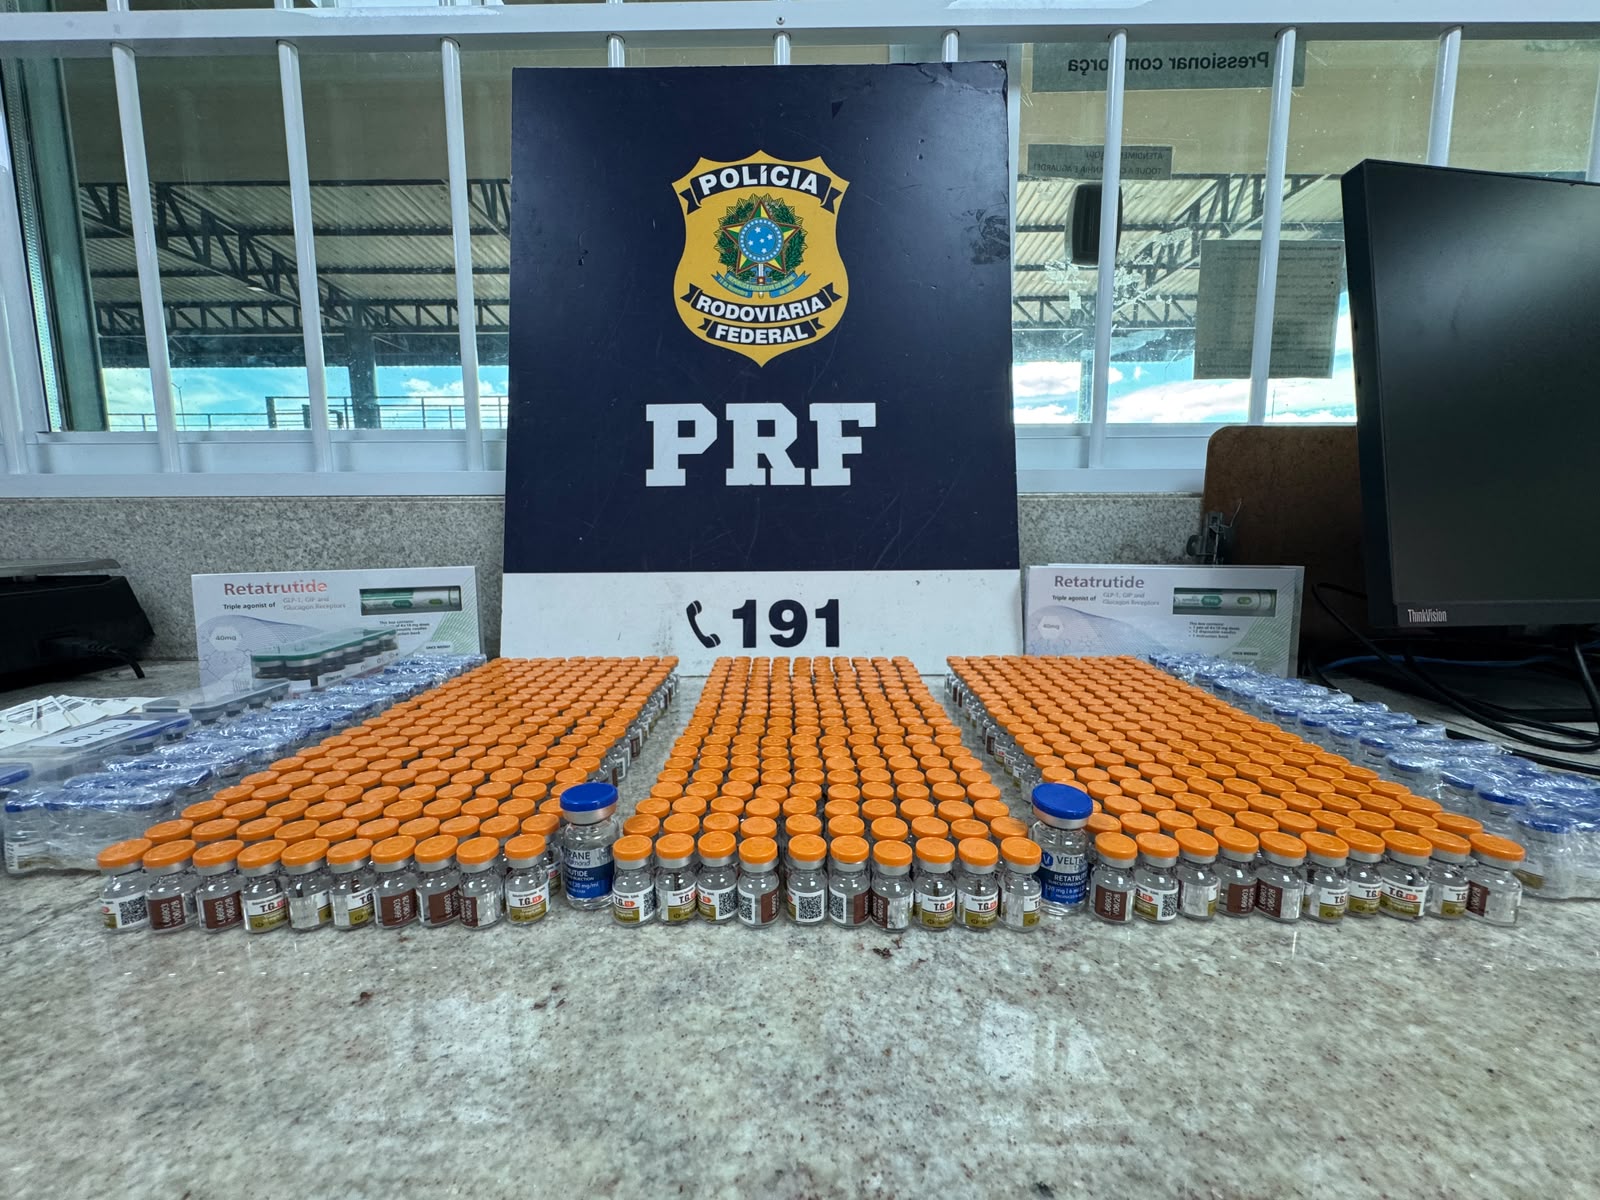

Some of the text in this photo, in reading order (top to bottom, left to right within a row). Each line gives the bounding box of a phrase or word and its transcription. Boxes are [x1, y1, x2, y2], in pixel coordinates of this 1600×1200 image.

[699, 165, 819, 196] POLÍCIA
[714, 324, 809, 344] FEDERAL
[645, 402, 876, 487] PRF
[223, 579, 328, 596] Retatrutide
[1054, 575, 1145, 589] Retatrutide
[242, 602, 267, 610] agonist
[732, 599, 840, 648] 191
[1407, 608, 1447, 623] ThinkVision
